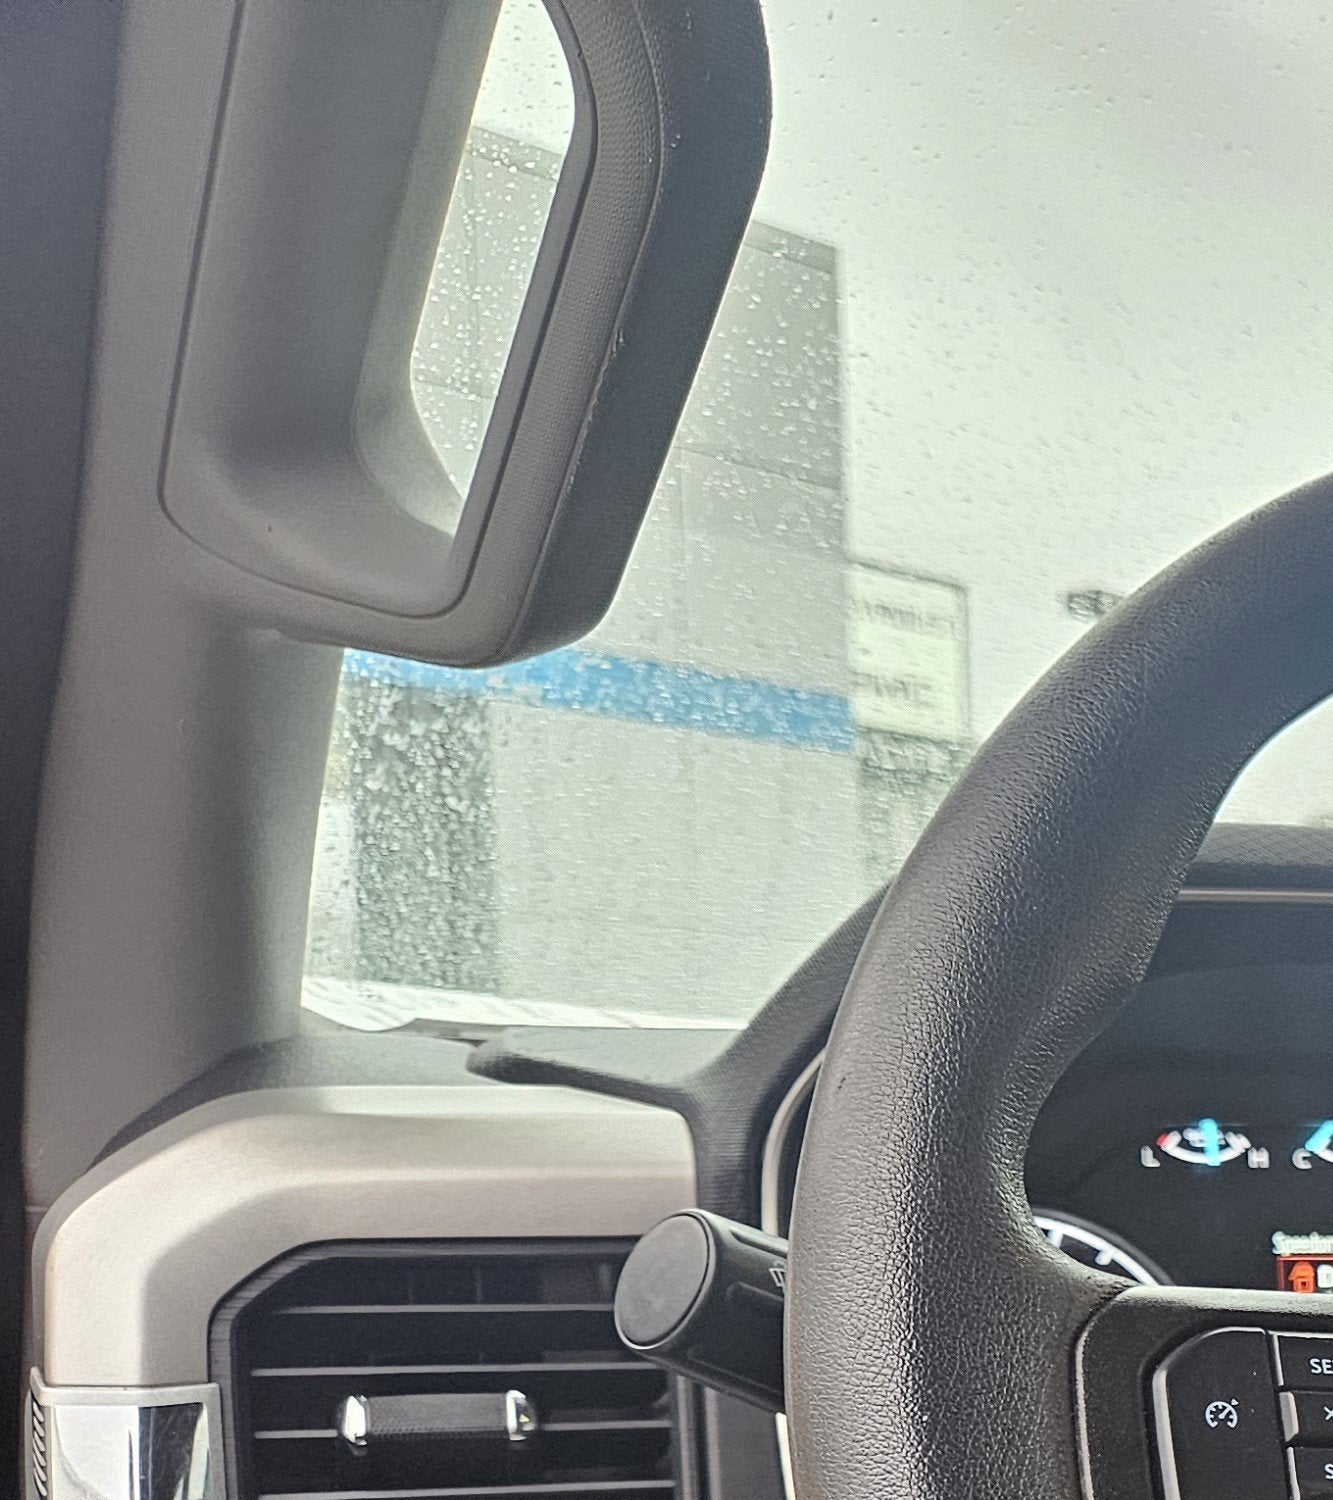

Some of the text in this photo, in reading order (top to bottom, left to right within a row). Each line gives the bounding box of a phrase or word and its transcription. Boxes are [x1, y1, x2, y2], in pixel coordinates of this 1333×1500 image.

[1141, 1146, 1161, 1167] L
[1248, 1147, 1270, 1169] H
[1292, 1150, 1312, 1169] C
